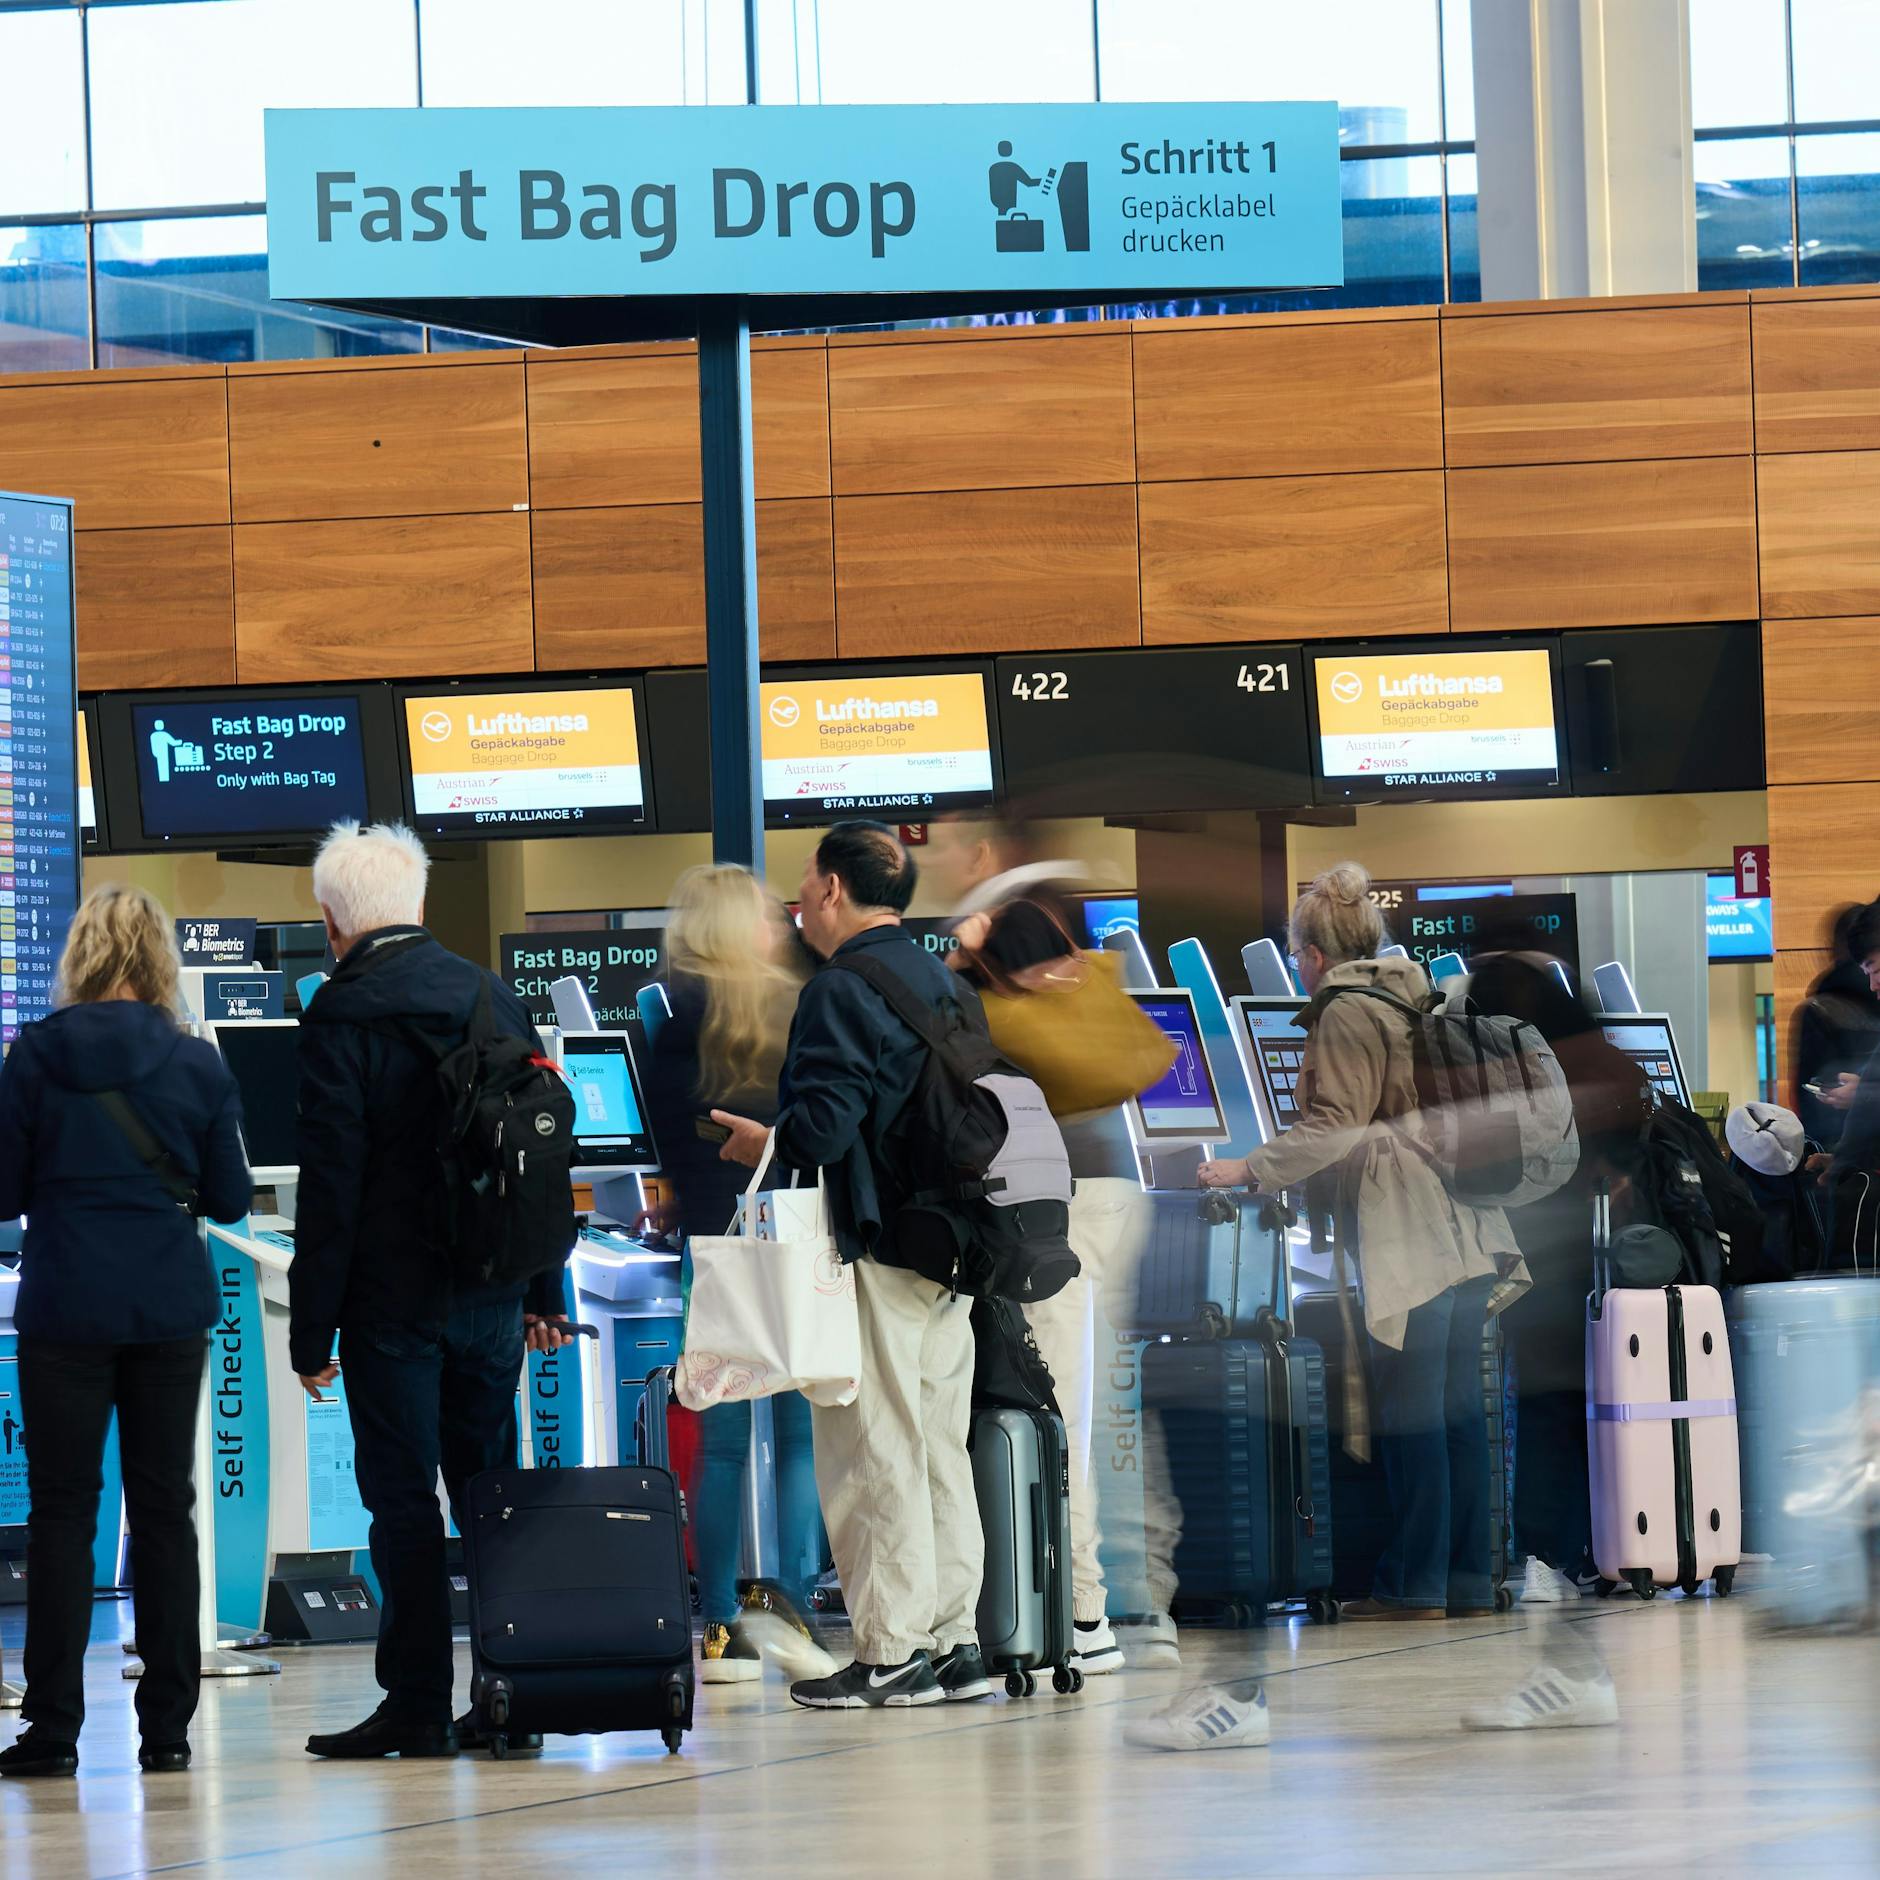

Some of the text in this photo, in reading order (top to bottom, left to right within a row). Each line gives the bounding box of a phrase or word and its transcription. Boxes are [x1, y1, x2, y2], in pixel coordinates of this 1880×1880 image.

[1120, 139, 1276, 175] Schritt 1
[316, 167, 916, 263] Fast Bag Drop
[1122, 193, 1276, 224] Gepäcklabel
[1123, 228, 1224, 252] drucken
[1237, 663, 1289, 692] 421
[1379, 673, 1504, 697] Lufthansa
[1012, 672, 1069, 700] 422
[816, 698, 938, 720] Lufthansa
[1382, 698, 1479, 712] Gepäckabgabe
[211, 713, 346, 738] Fast Bag Drop
[467, 712, 589, 736] Lufthansa
[1382, 713, 1470, 727] Baggage Drop
[819, 721, 915, 736] Gepäckabgabe
[471, 736, 565, 751] Gepäckabgabe
[820, 736, 906, 752] Baggage Drop
[1346, 739, 1396, 751] Austrian
[1471, 734, 1506, 742] brussels
[213, 741, 274, 765] Step 2
[471, 751, 557, 765] Baggage Drop
[907, 757, 942, 766] brussels
[1373, 759, 1408, 768] SWISS
[558, 772, 592, 780] brussels
[785, 764, 833, 775] Austrian
[216, 770, 336, 790] Only with Bag Tag
[436, 777, 485, 789] Austrian
[1385, 772, 1482, 785] STAR ALLIANCE
[812, 782, 846, 792] SWISS
[463, 796, 498, 806] SWISS
[823, 795, 919, 809] STAR ALLIANCE
[475, 809, 570, 823] STAR ALLIANCE
[203, 924, 219, 937] BER
[1412, 916, 1455, 936] Fast
[201, 937, 244, 952] Biometrics
[924, 934, 961, 953] Dro
[513, 946, 658, 971] Fast Bag Drop
[588, 976, 599, 994] 2
[238, 1007, 263, 1016] Biometrics
[216, 1268, 243, 1497] Self Check-in
[536, 1409, 561, 1469] Self
[1108, 1404, 1137, 1472] Self
